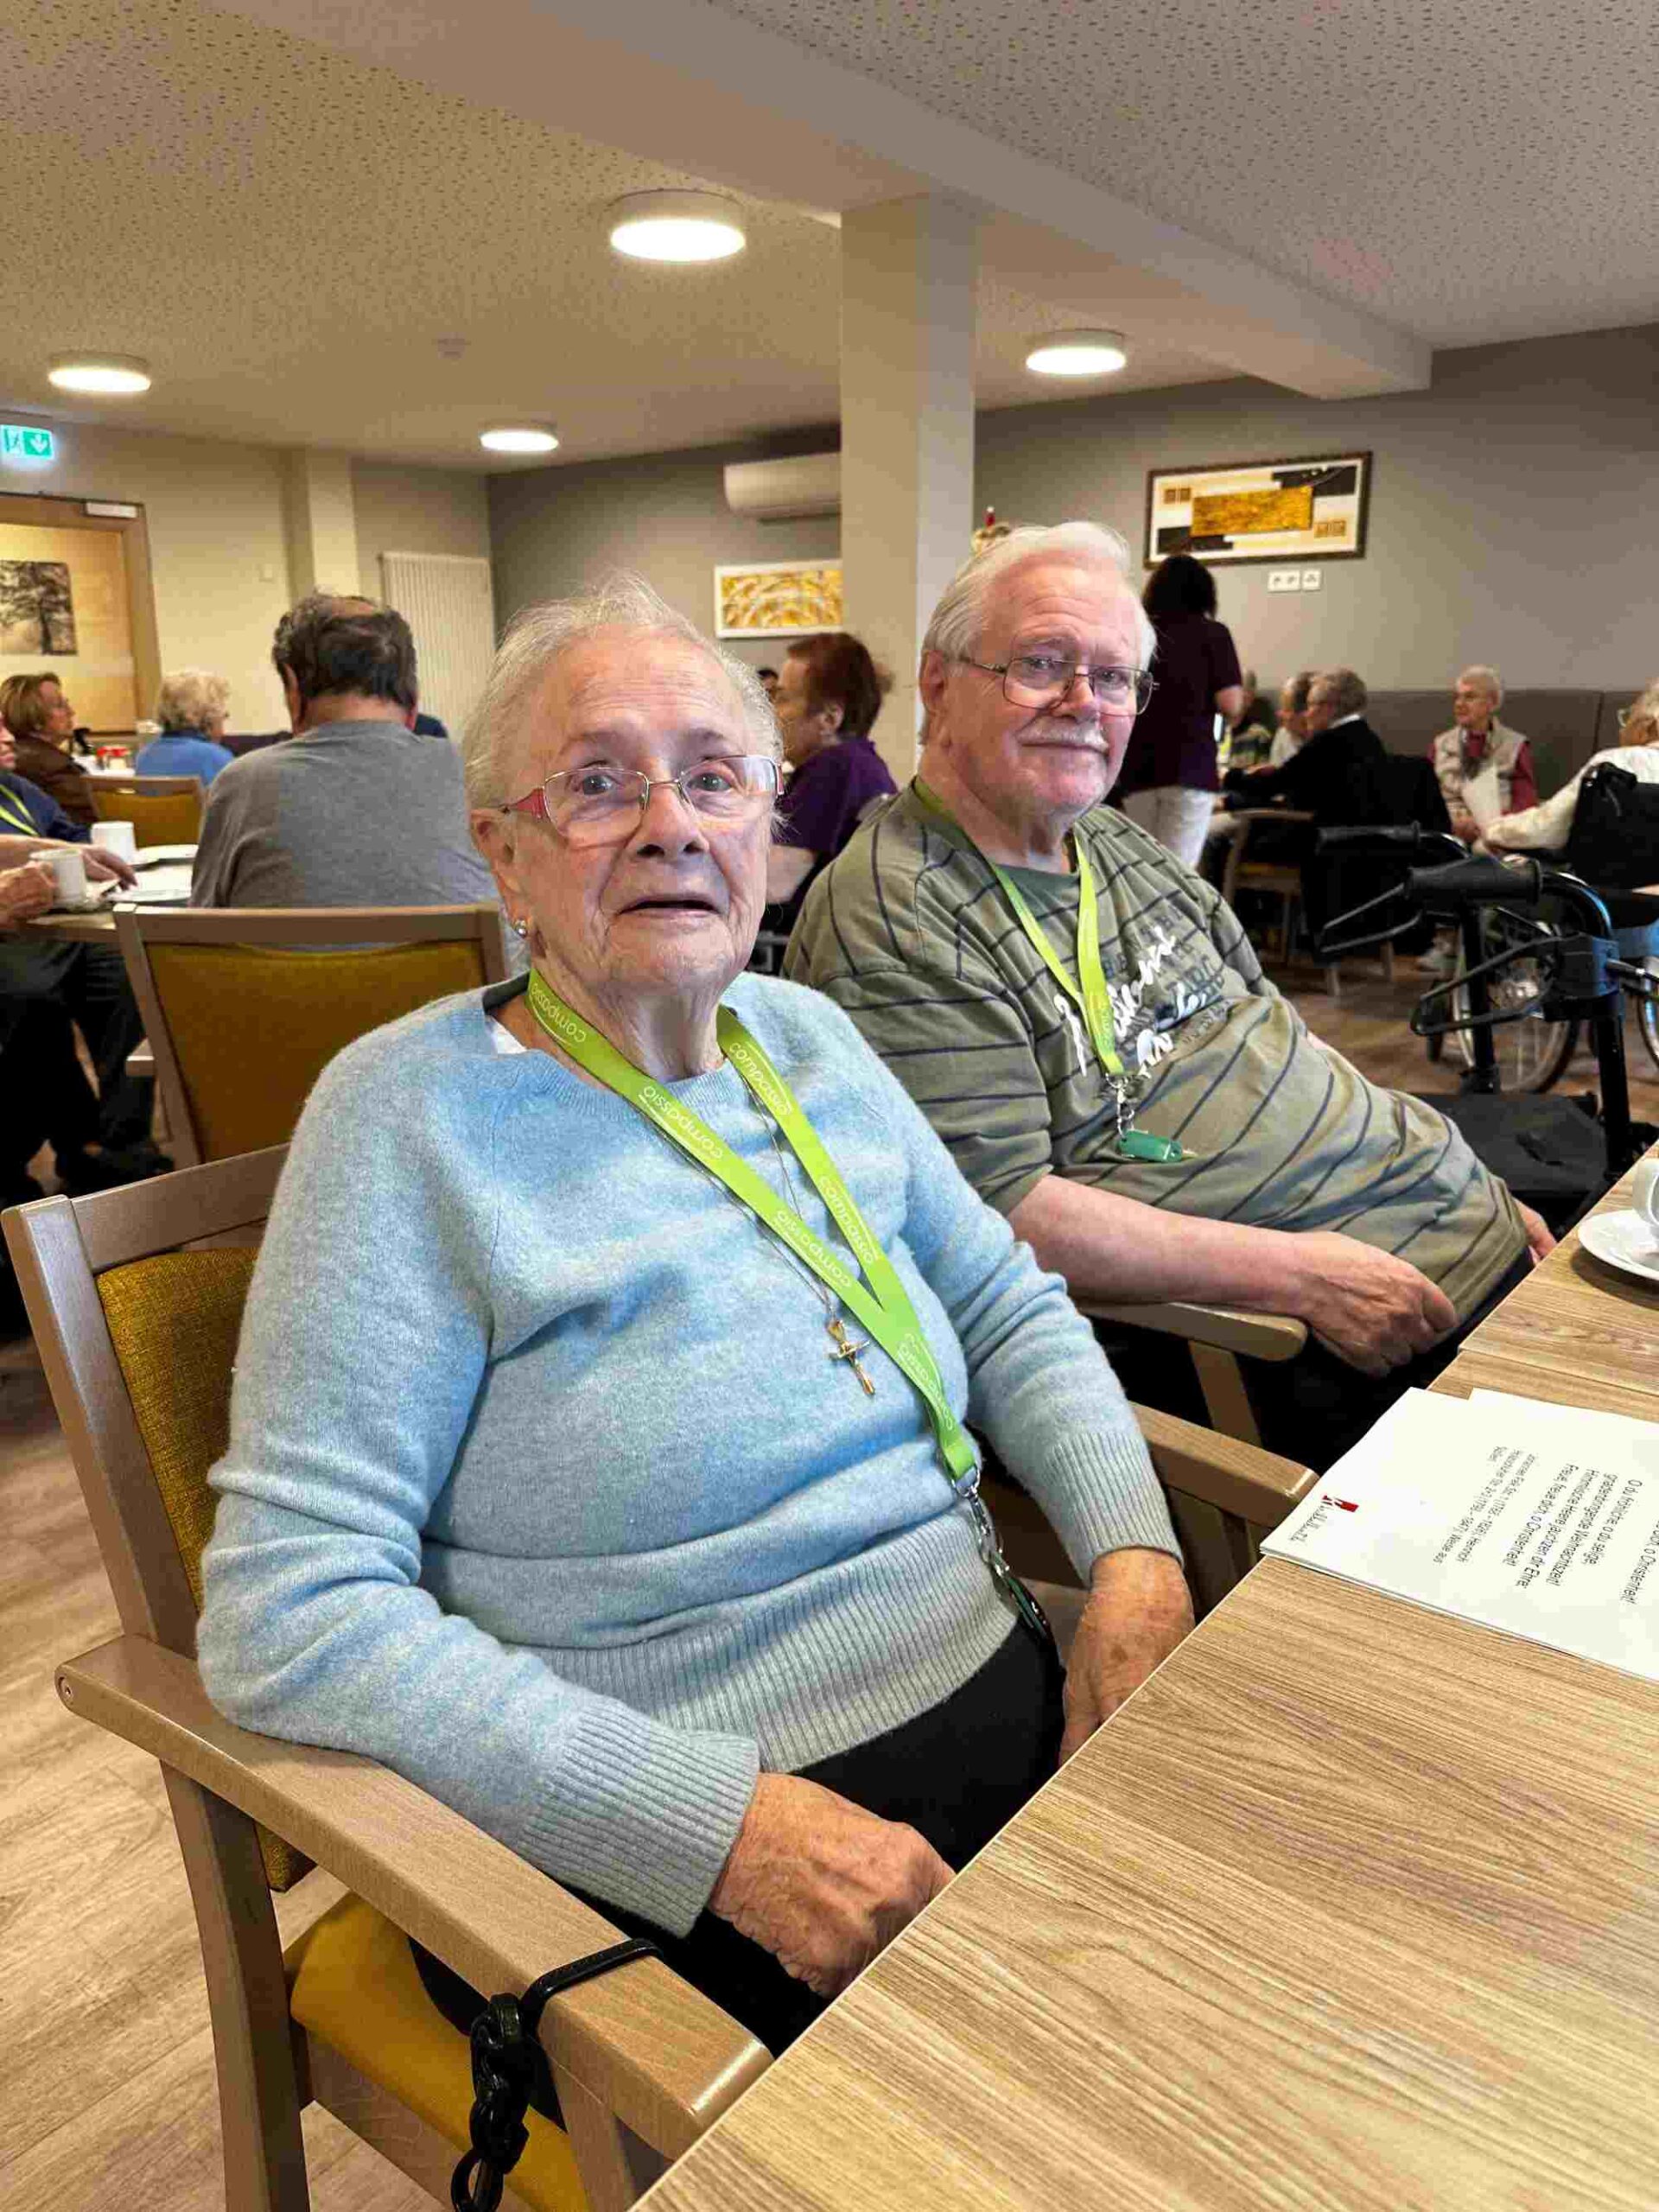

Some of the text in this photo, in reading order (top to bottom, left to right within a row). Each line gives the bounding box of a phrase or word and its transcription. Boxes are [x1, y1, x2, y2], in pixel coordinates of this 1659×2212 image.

[644, 1086, 722, 1159] compassio
[1626, 1478, 1643, 1487] O
[1621, 1486, 1639, 1497] du
[1554, 1504, 1577, 1525] Heere
[1595, 1532, 1611, 1543] du
